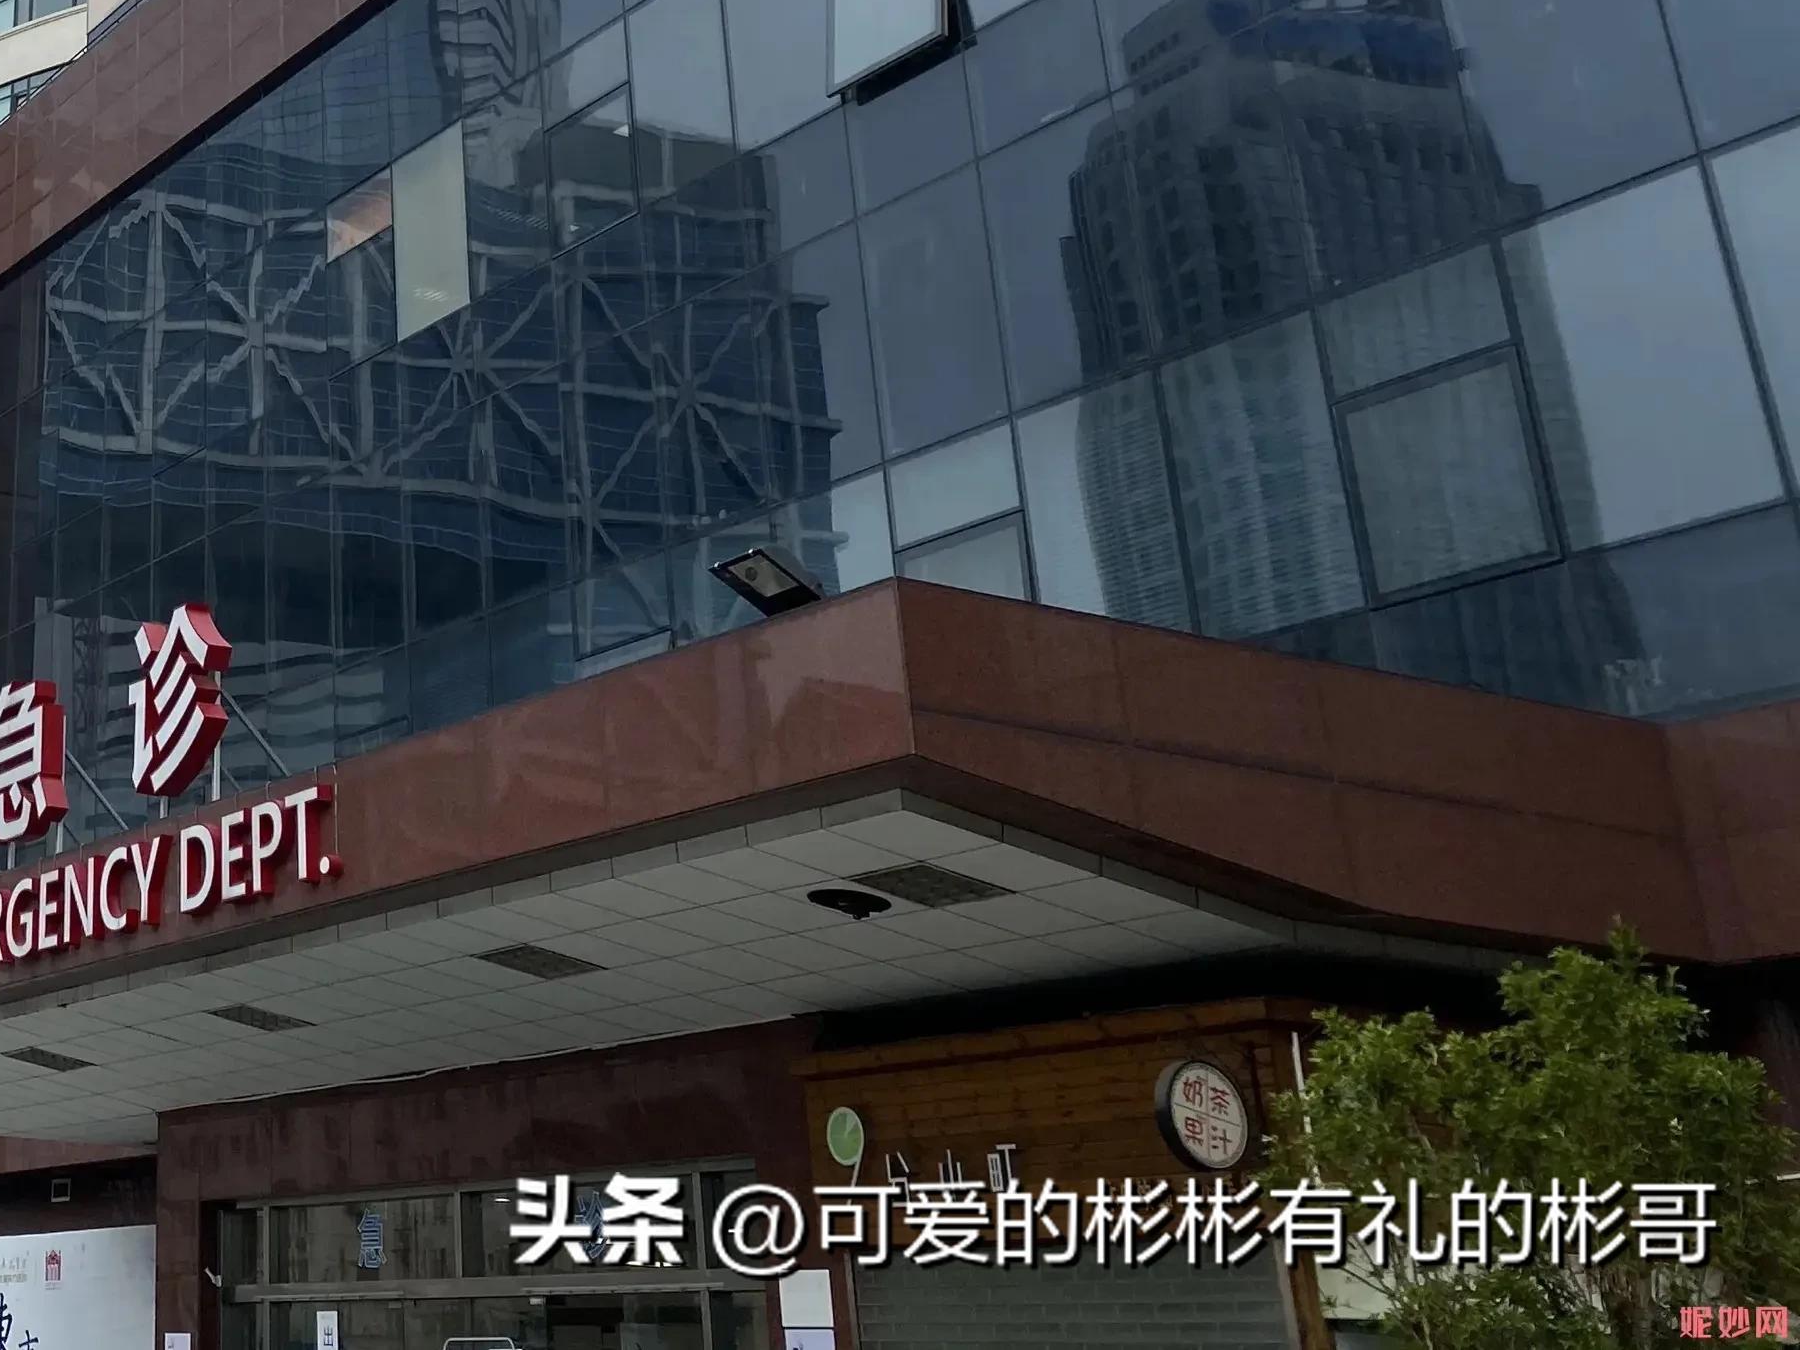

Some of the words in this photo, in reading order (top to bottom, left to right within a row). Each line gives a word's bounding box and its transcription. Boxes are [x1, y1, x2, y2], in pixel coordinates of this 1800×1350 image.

[180, 786, 338, 914] DEPT.
[1183, 1075, 1230, 1116] 奶茶
[1185, 1116, 1233, 1155] 果汁
